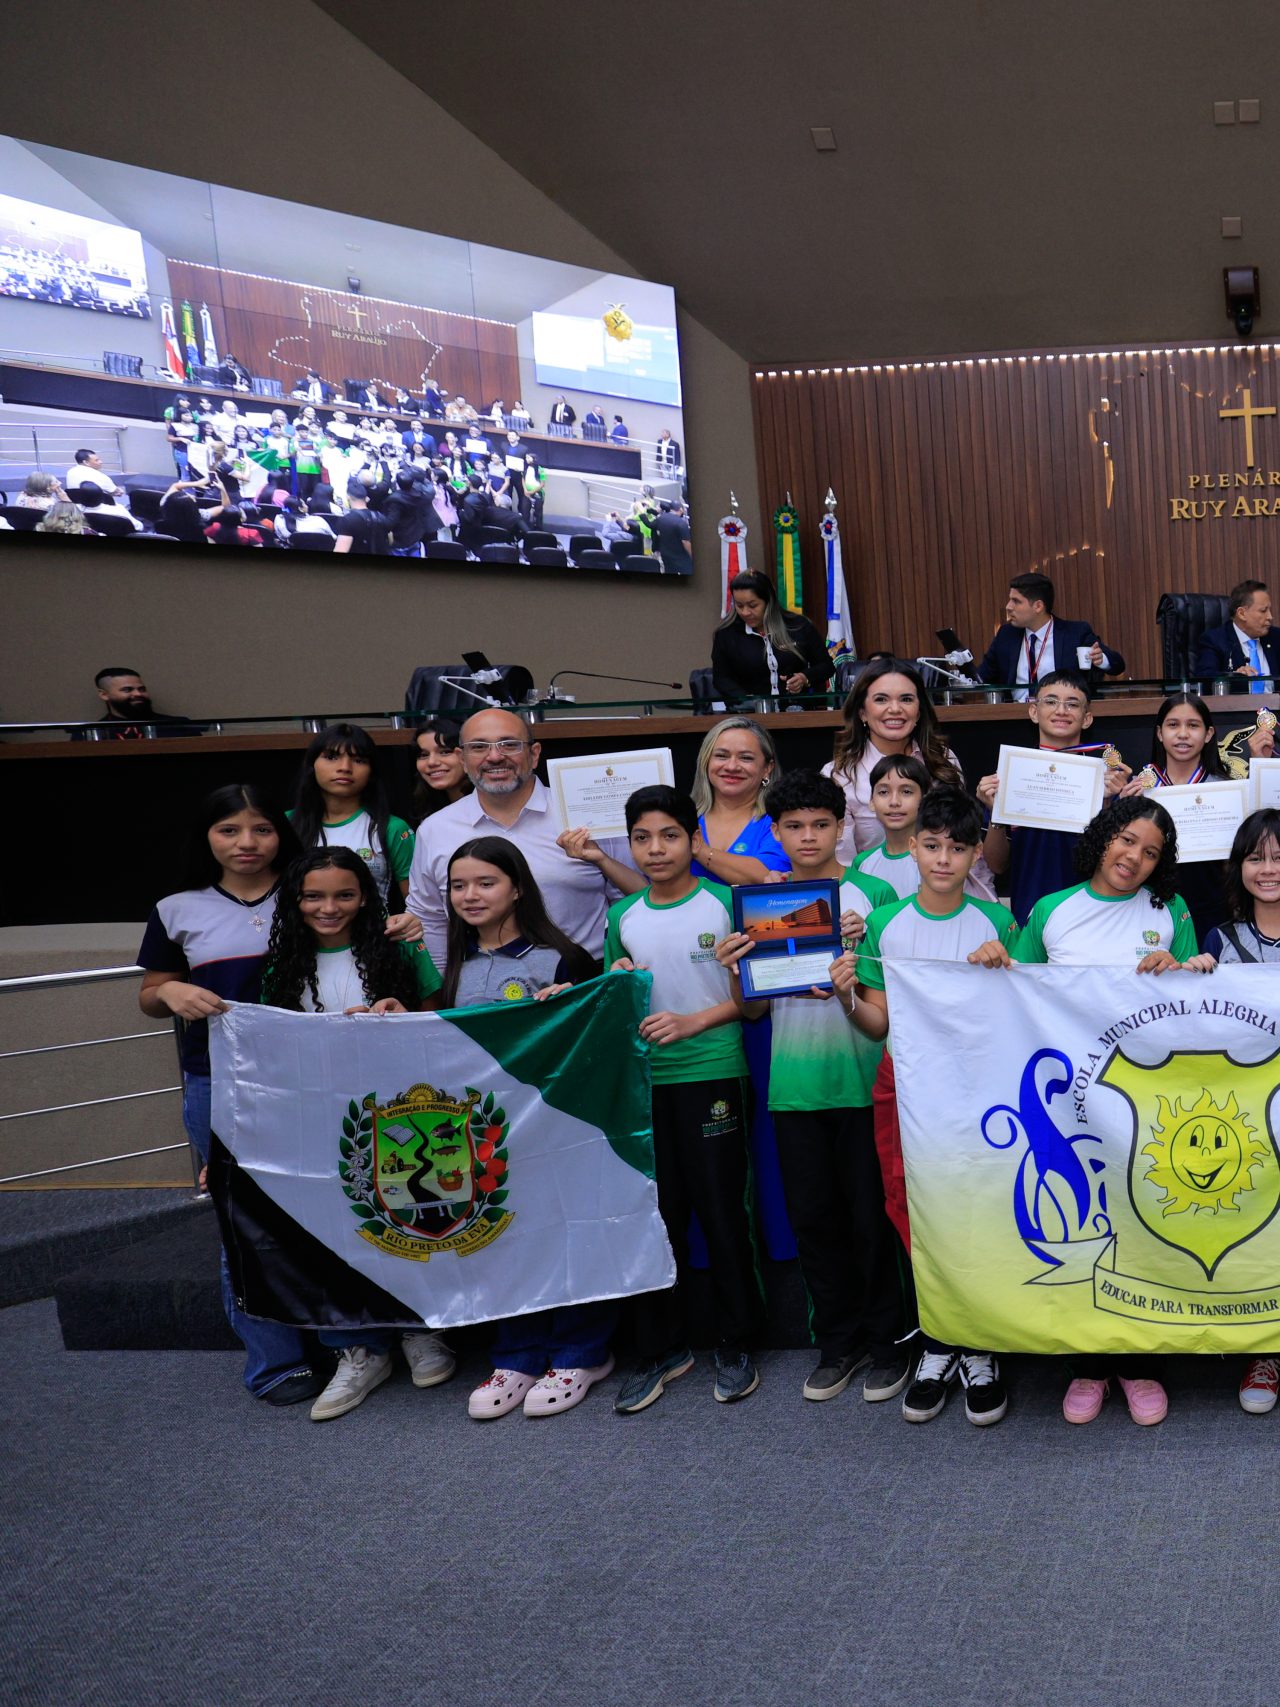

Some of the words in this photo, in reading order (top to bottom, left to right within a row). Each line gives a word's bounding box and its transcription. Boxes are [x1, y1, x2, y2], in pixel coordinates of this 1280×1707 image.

[1170, 498, 1227, 520] RUY
[767, 898, 807, 907] Homenagem
[1074, 1049, 1101, 1126] ESCOLA
[1098, 999, 1192, 1049] MUNICIPAL
[1198, 999, 1279, 1037] ALEGRIA
[386, 1104, 420, 1117] INTEGRAÇÃO
[426, 1104, 460, 1115] PROGRESSO
[386, 1232, 408, 1247] RIO
[410, 1240, 450, 1251] PRETO
[454, 1235, 468, 1246] DA
[469, 1222, 488, 1239] EVA
[1100, 1280, 1148, 1311] EDUCAR
[1150, 1297, 1185, 1316] PARA
[1187, 1298, 1280, 1317] TRANSFORMAR
